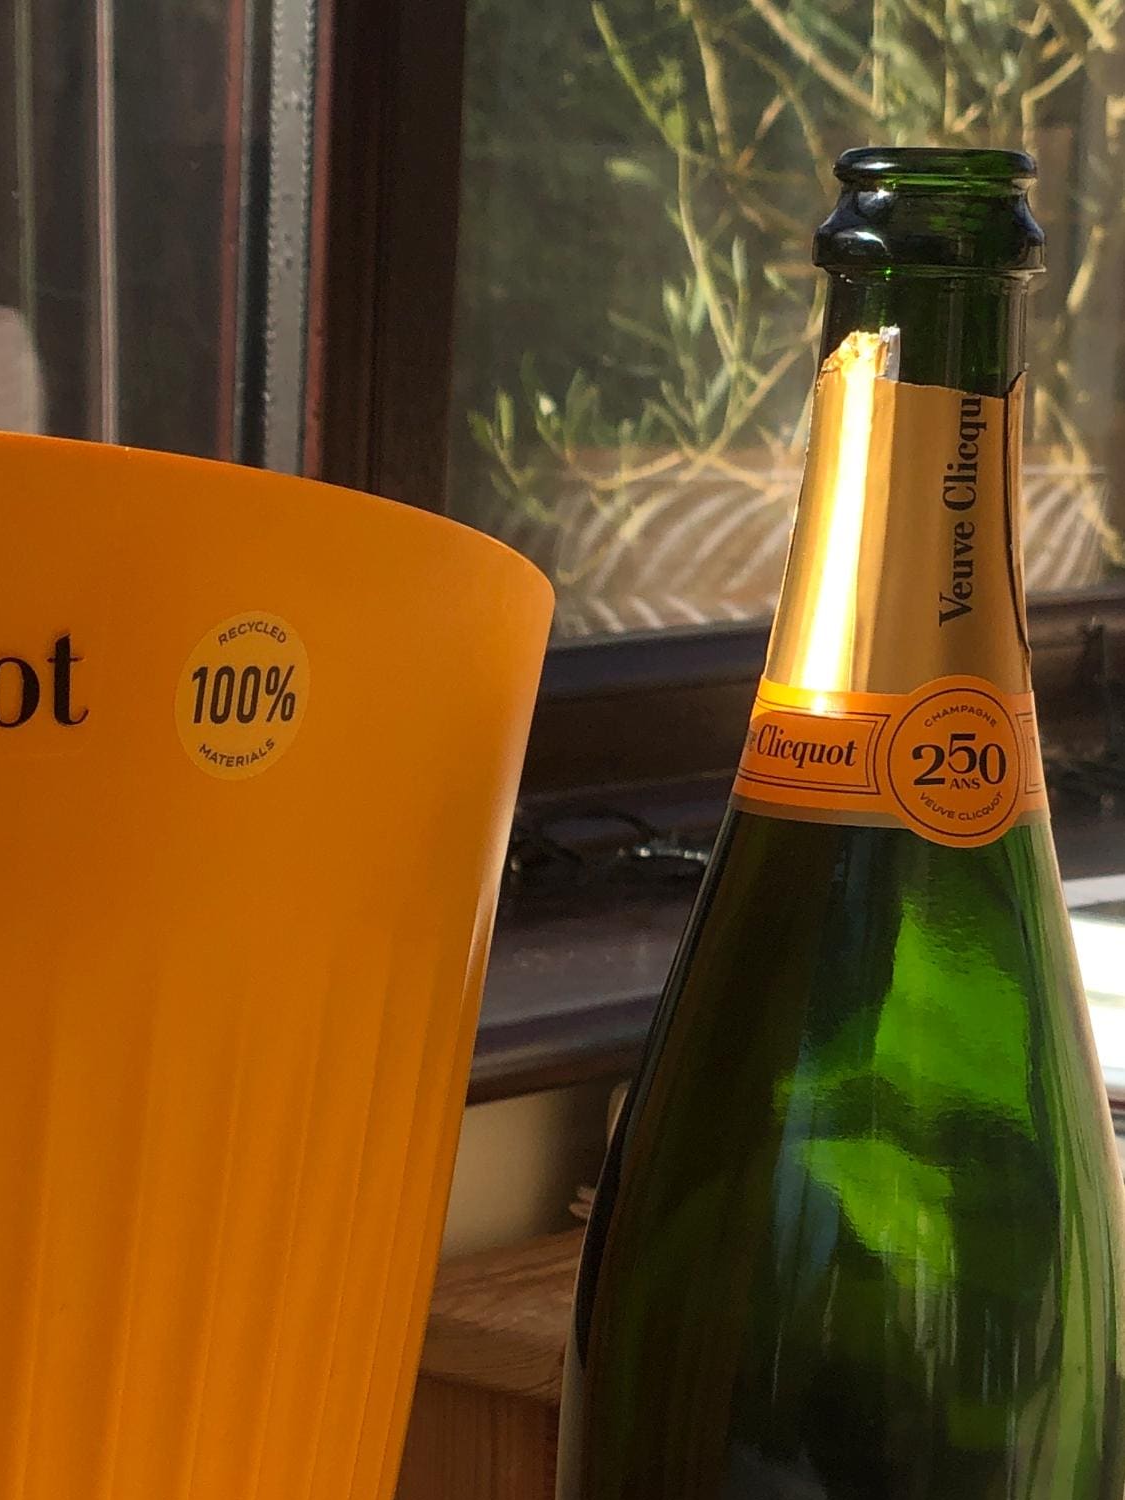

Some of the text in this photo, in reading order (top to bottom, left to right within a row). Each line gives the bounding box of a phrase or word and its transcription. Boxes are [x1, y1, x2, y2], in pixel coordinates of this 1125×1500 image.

[939, 520, 975, 627] Veuve
[218, 620, 287, 646] RECYCLED
[192, 665, 296, 724] 100%
[924, 705, 997, 729] CHAMPAGNE
[199, 738, 275, 768] MATERIALS
[757, 723, 858, 769] Clicquot
[912, 733, 1007, 786] 250
[949, 777, 981, 790] ANS
[920, 791, 1004, 821] VEUVE CLICQUOT
